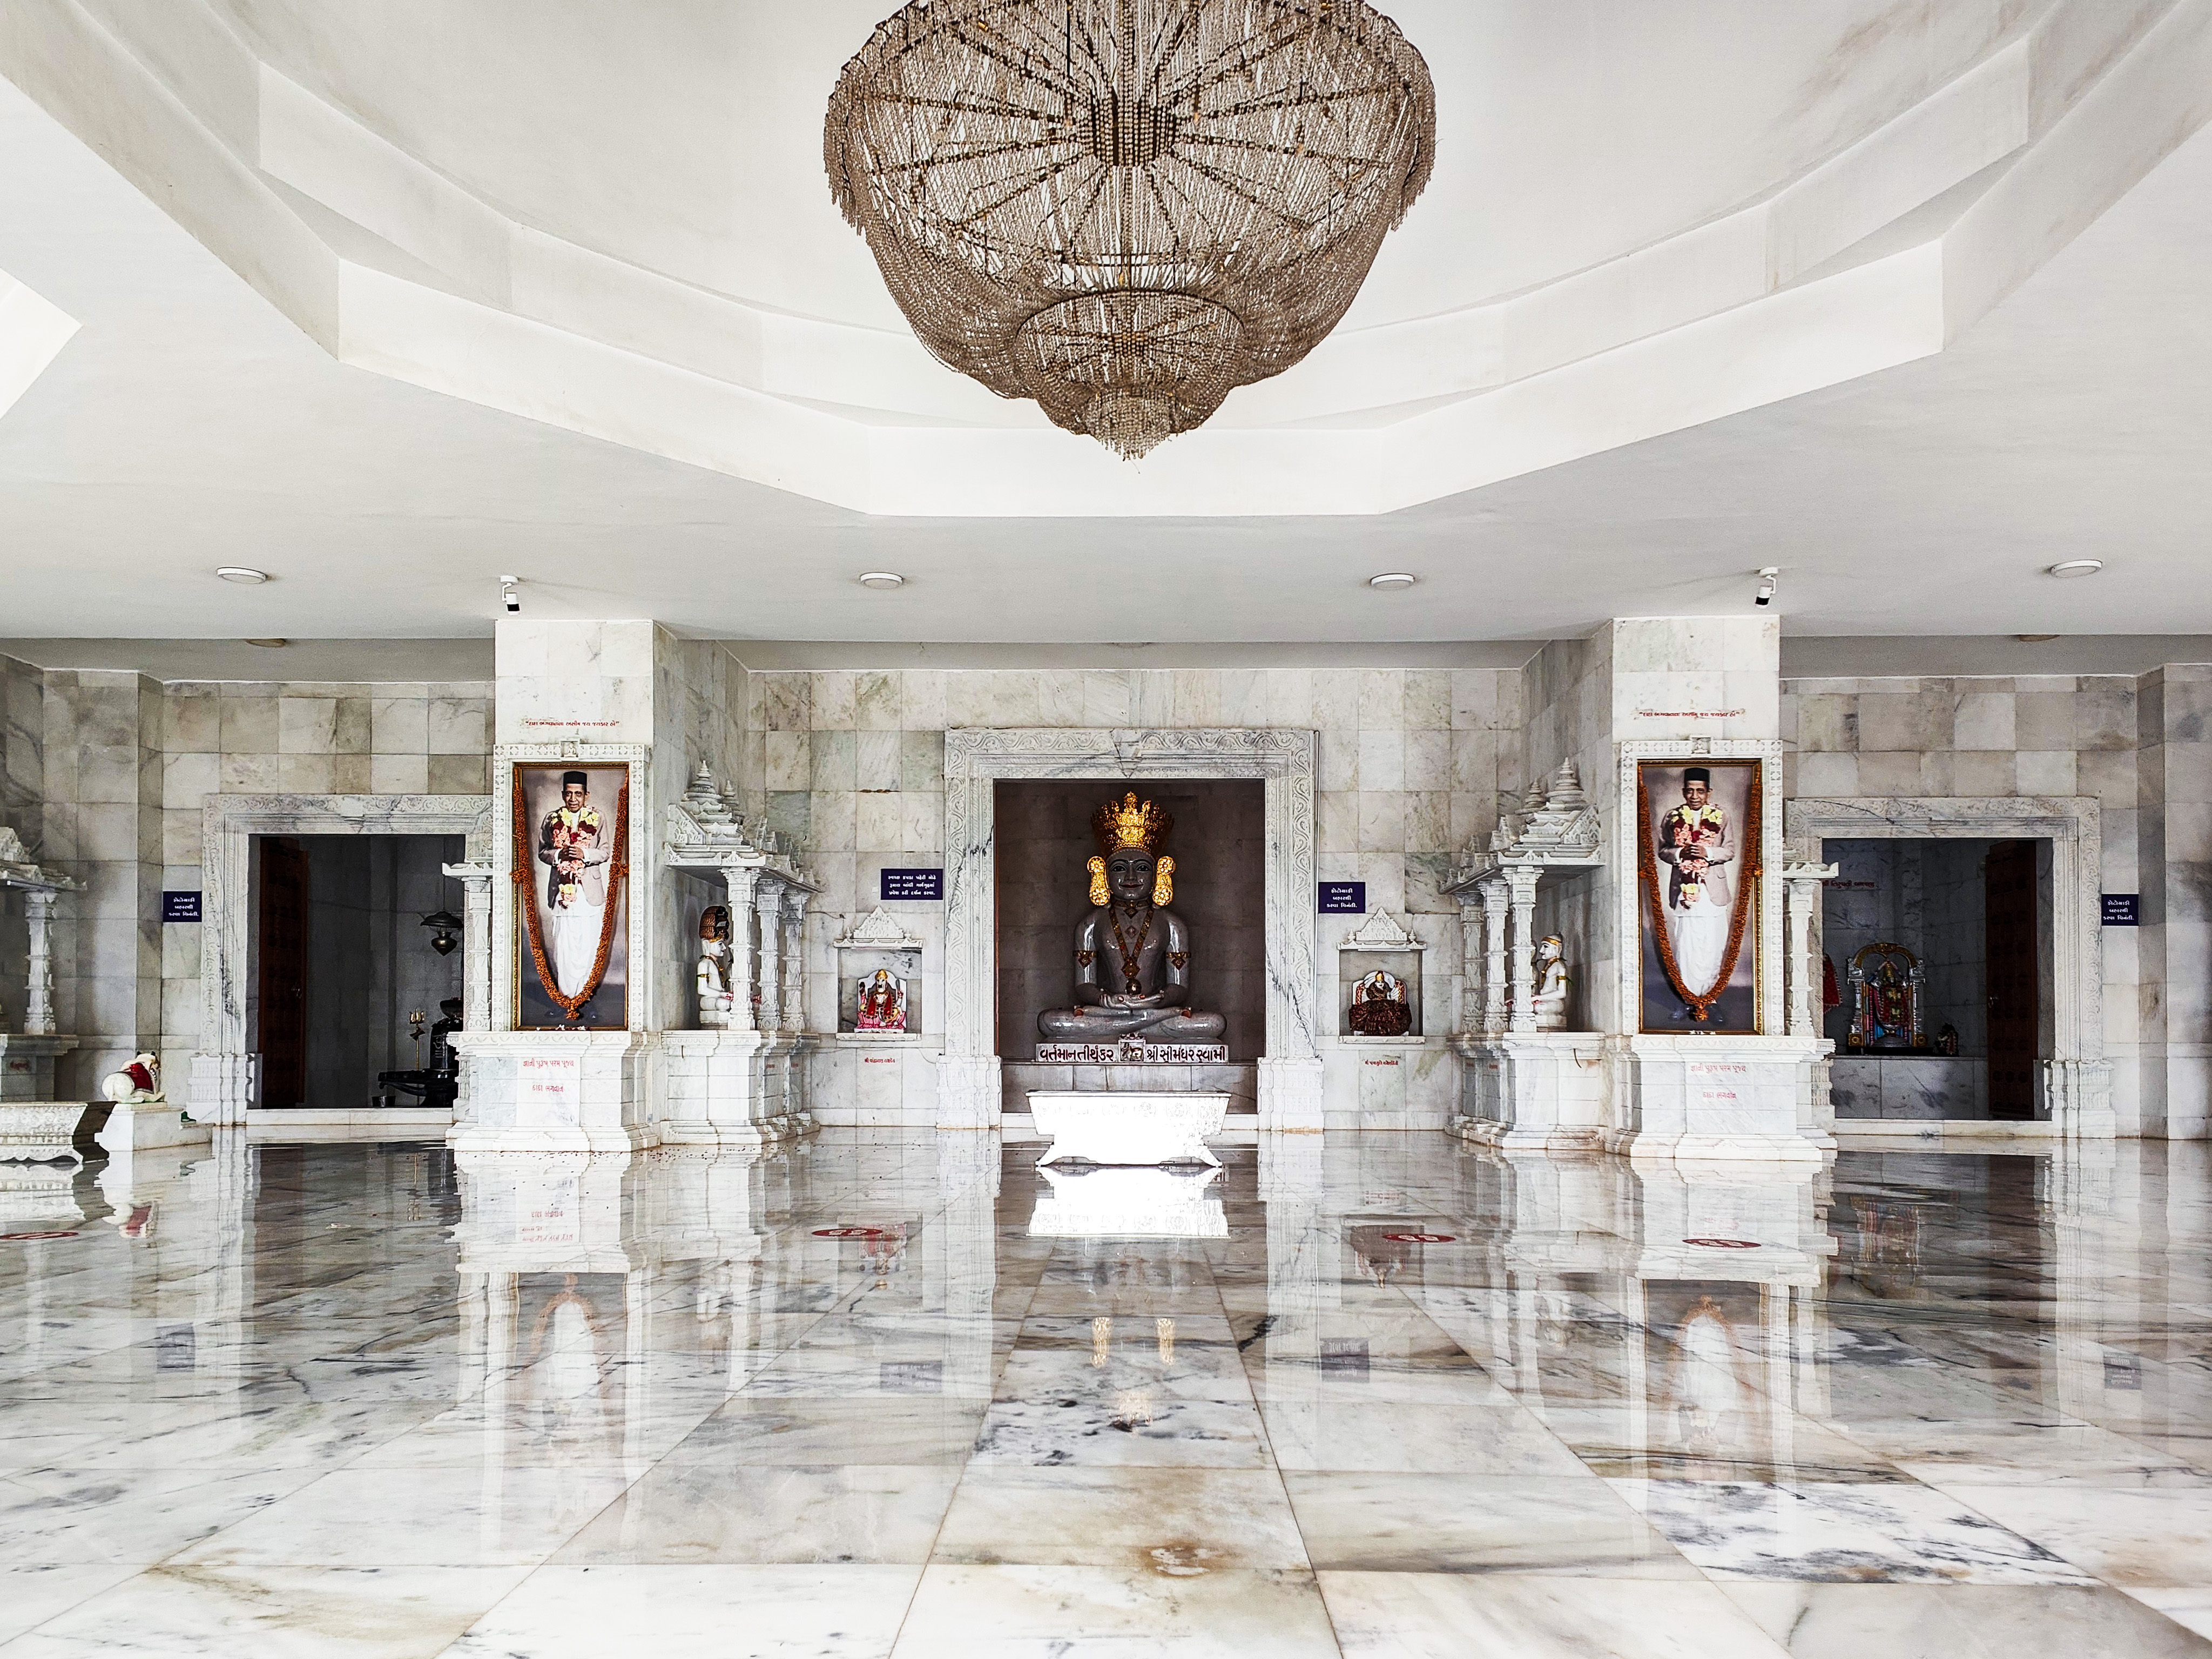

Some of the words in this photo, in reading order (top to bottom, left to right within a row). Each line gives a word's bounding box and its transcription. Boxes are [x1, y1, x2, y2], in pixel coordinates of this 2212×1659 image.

[1040, 1044, 1076, 1061] વર્તમાન
[1147, 1045, 1158, 1061] શ્રી
[1159, 1046, 1195, 1061] સીમંધર
[1196, 1046, 1225, 1061] સ્વામી
